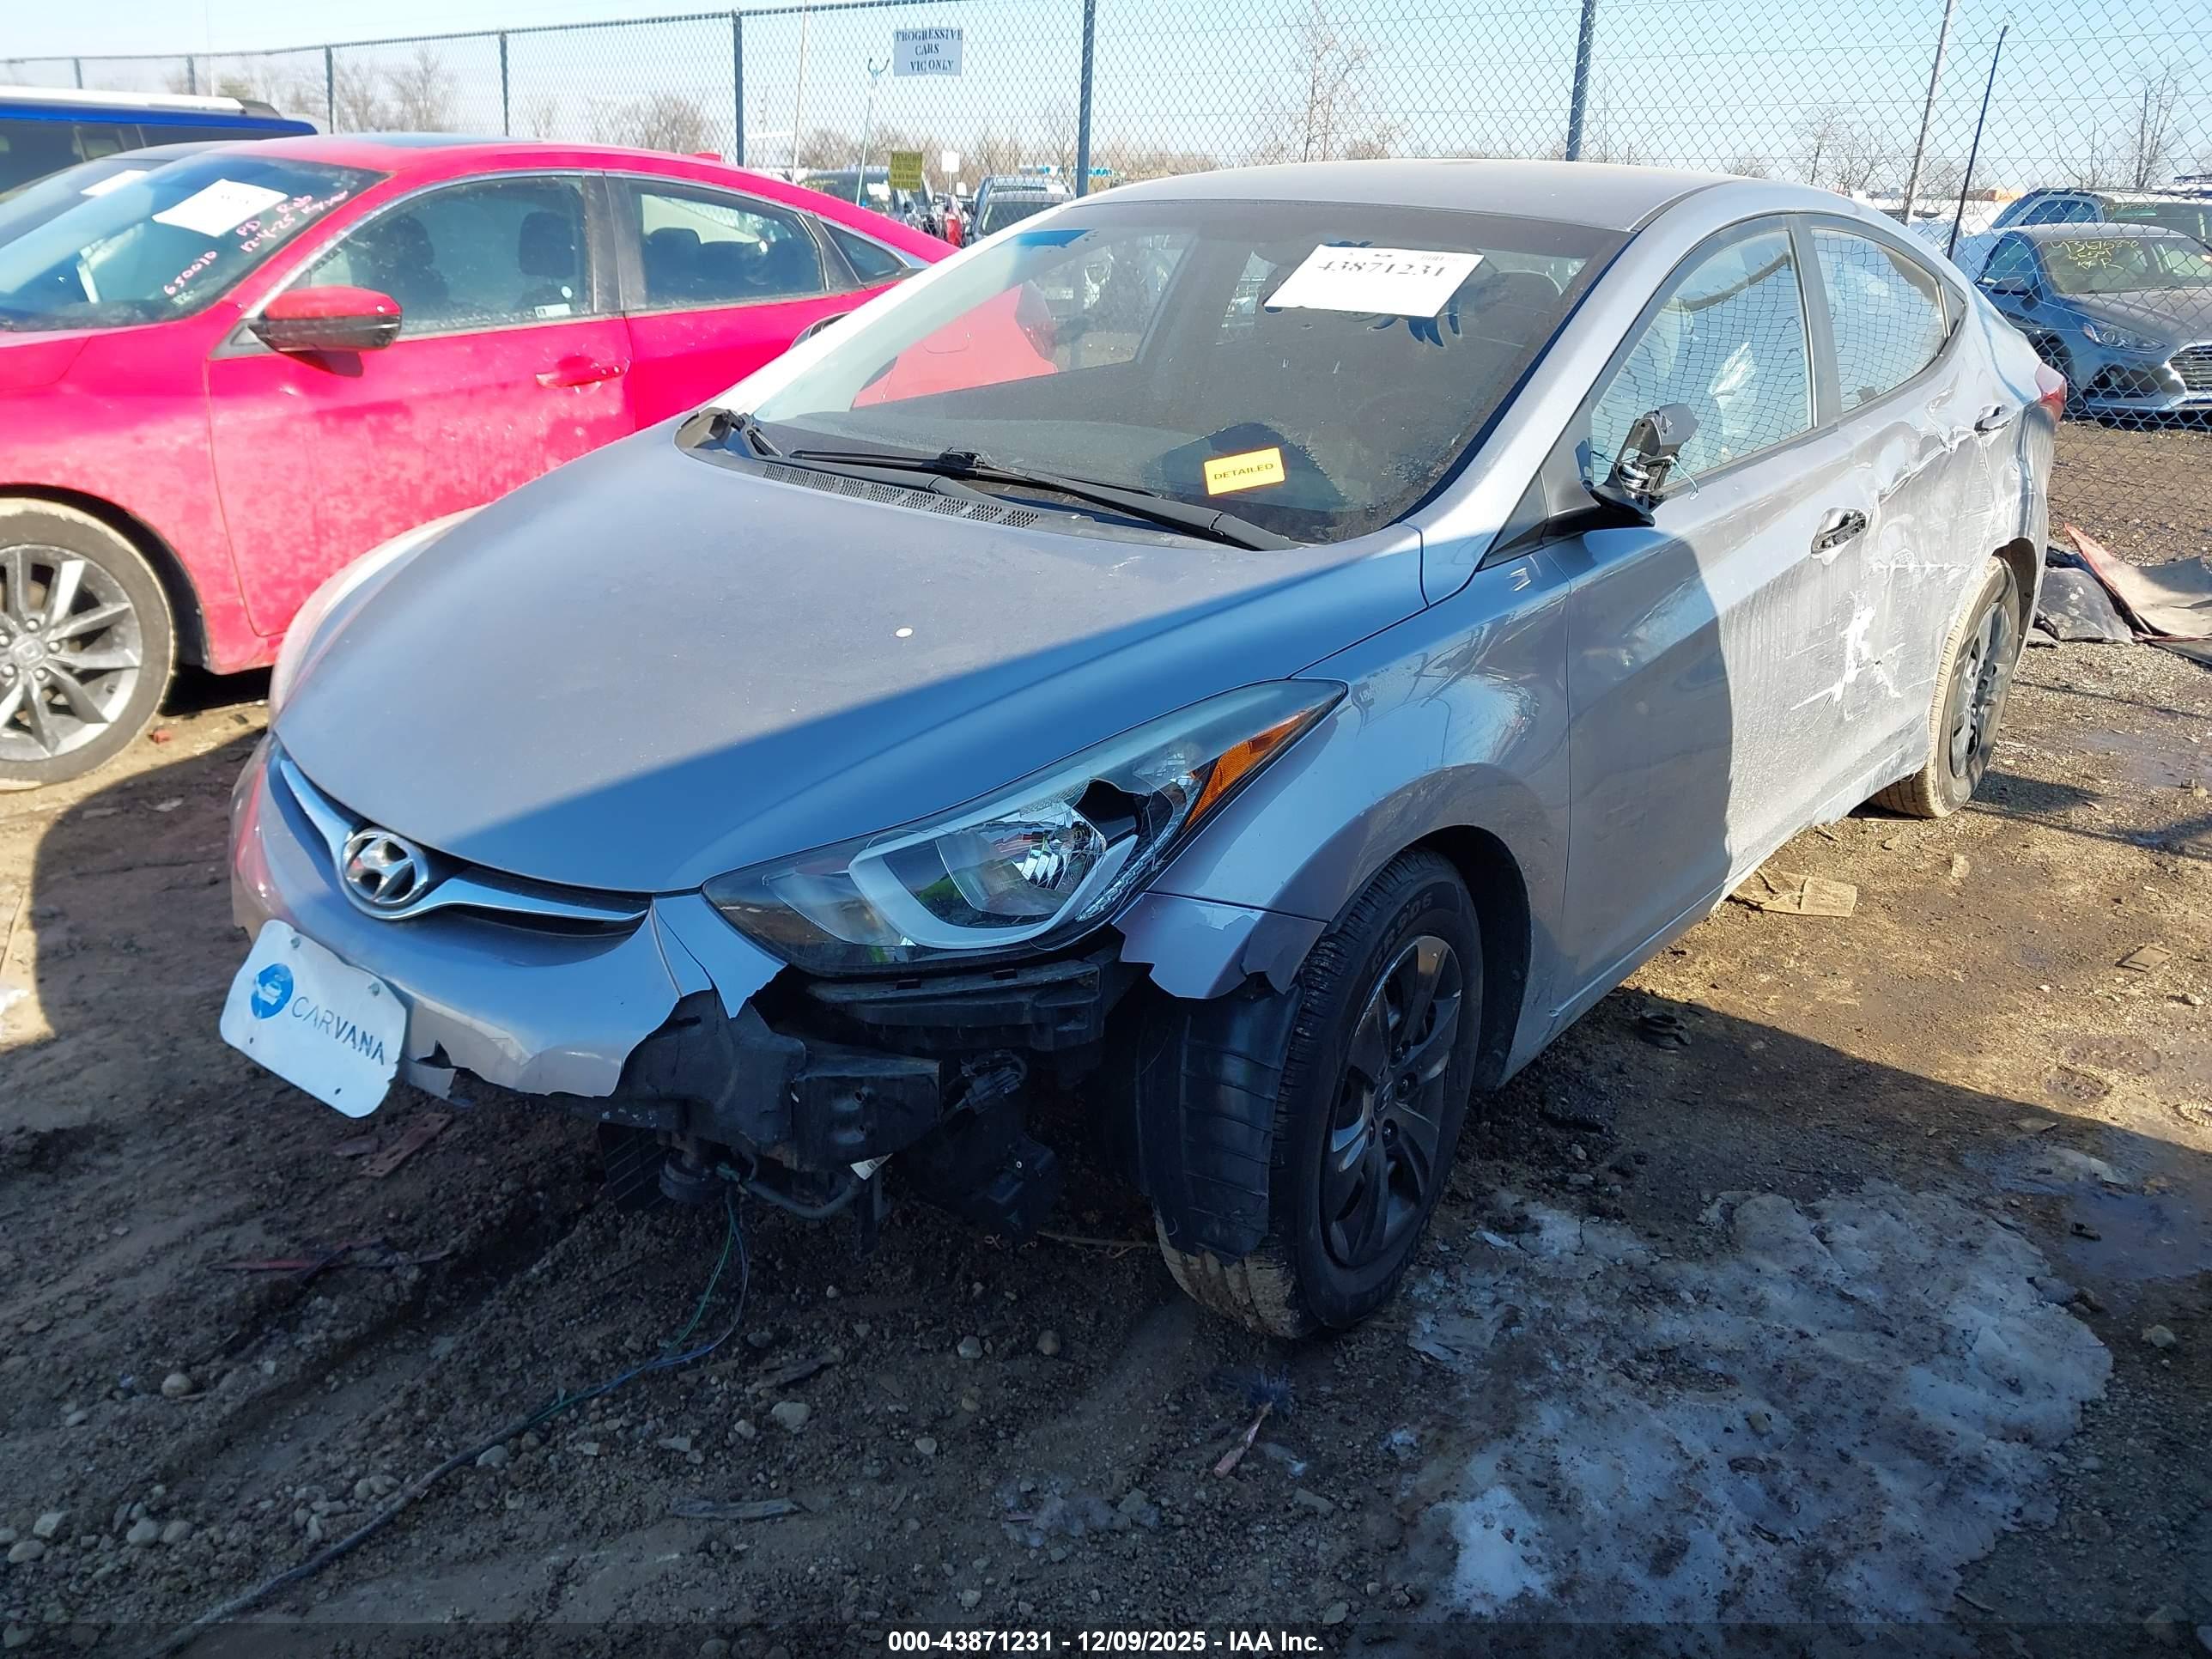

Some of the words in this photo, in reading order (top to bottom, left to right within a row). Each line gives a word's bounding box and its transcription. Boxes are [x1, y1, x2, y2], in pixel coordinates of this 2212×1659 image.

[896, 27, 962, 42] PROGRESSIVE
[915, 43, 939, 56] CARS
[928, 59, 954, 70] ONLY
[1318, 261, 1445, 276] 43871231
[1213, 463, 1274, 480] DETAILED
[292, 996, 384, 1066] CARVANA
